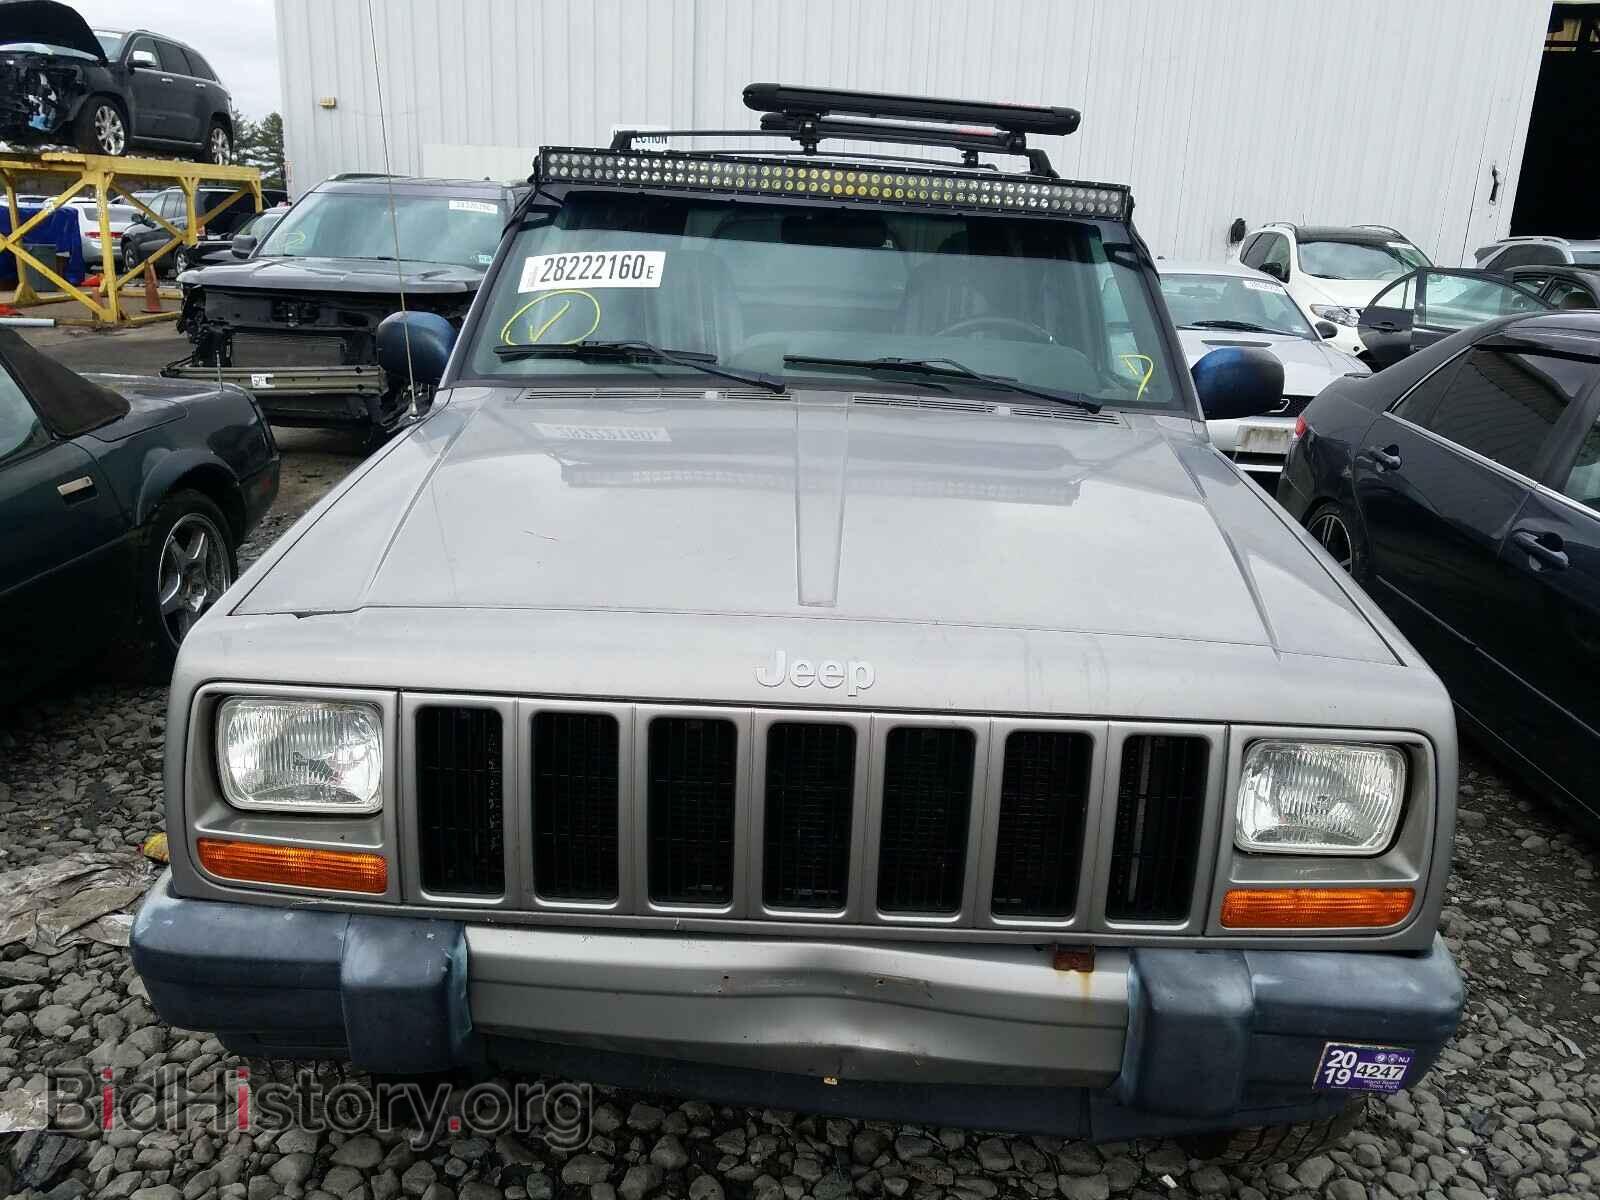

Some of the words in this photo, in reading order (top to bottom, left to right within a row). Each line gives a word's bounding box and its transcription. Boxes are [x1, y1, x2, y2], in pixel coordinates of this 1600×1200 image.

[540, 254, 645, 282] 28222160
[753, 650, 876, 697] Jeep
[1327, 1050, 1357, 1069] 20
[1325, 1068, 1352, 1085] 19
[1357, 1065, 1403, 1078] 4247
